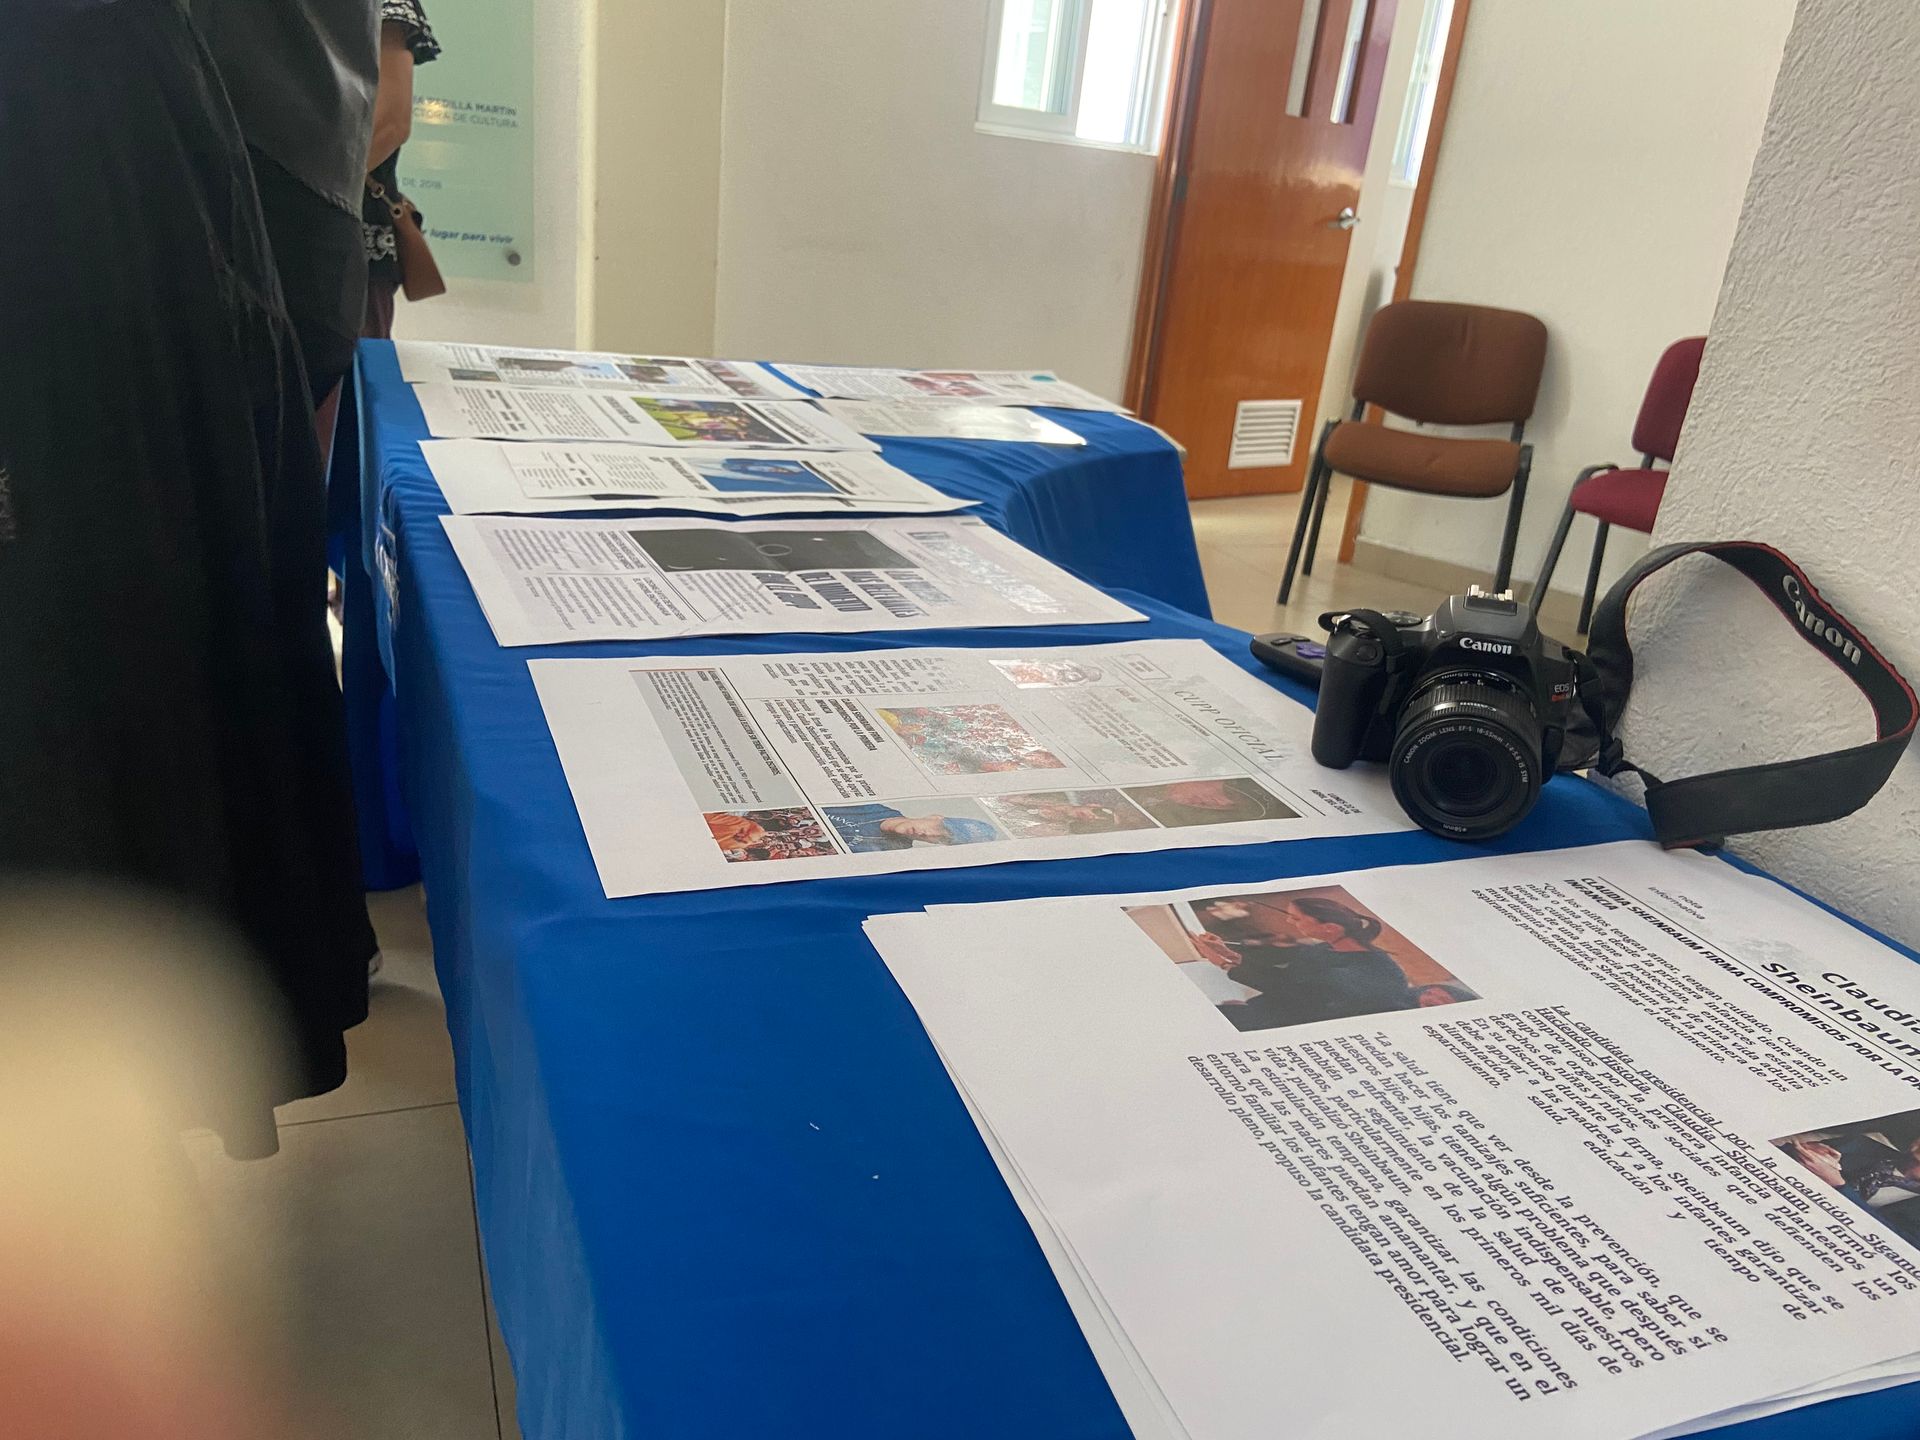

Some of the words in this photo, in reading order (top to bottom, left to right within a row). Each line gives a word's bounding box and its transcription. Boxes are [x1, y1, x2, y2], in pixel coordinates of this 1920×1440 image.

[430, 228, 459, 240] lugar
[461, 232, 487, 242] para
[1460, 637, 1512, 655] Canon
[1554, 683, 1569, 693] EOS
[1782, 575, 1861, 665] Canon
[1174, 690, 1220, 716] CUPP
[1215, 717, 1285, 761] OFICIAL
[1404, 744, 1419, 764] CANON
[1419, 732, 1437, 745] ZOOM
[1439, 727, 1455, 735] LENS
[1477, 728, 1503, 743] 18-55mm
[1471, 889, 1521, 922] aspirantes
[1514, 922, 1600, 971] presidenciales
[1589, 971, 1606, 981] en
[1603, 981, 1649, 1006] firmar
[1643, 1007, 1661, 1015] el
[1655, 1016, 1725, 1064] documento.
[1561, 878, 1620, 910] INFANCIA
[1580, 877, 1632, 906] CLAUDIA
[1621, 905, 1705, 950] SHEINBAUM
[1697, 950, 1746, 977] FIRMA
[1739, 977, 1852, 1041] COMPROMISOS
[1843, 1041, 1886, 1062] POR
[1877, 1061, 1905, 1076] LA
[1647, 886, 1706, 920] informativa
[1678, 895, 1703, 909] nota
[1421, 1024, 1500, 1088] esparcimiento.
[1563, 897, 1583, 908] los
[1579, 908, 1611, 927] niños
[1602, 927, 1648, 952] tengan
[1643, 952, 1680, 974] amor,
[1680, 974, 1723, 1000] tengan
[1722, 1001, 1773, 1035] cuidado.
[1776, 1035, 1827, 1067] Cuando
[1826, 1068, 1848, 1081] un
[1311, 1039, 1358, 1075] puedan
[1358, 1079, 1415, 1130] enfrentar,
[1416, 1134, 1435, 1147] la
[1436, 1151, 1511, 1219] vacunación
[1512, 1225, 1615, 1320] indispensable,
[1616, 1326, 1665, 1361] pero
[1390, 1050, 1429, 1076] salud
[1424, 1080, 1458, 1105] tiene
[1456, 1109, 1485, 1129] que
[1487, 1133, 1513, 1152] ver
[1512, 1158, 1555, 1191] desde
[1553, 1195, 1574, 1209] la
[1570, 1213, 1660, 1288] prevención,
[1665, 1294, 1702, 1320] que
[1704, 1326, 1728, 1343] se
[1437, 1022, 1511, 1081] alimentación,
[1526, 1095, 1569, 1125] salud,
[1582, 1140, 1653, 1195] educación
[1665, 1211, 1687, 1219] y
[1703, 1238, 1760, 1282] tiempo
[1781, 1303, 1807, 1320] de
[1470, 1017, 1491, 1030] En
[1487, 1031, 1508, 1043] su
[1504, 1043, 1558, 1081] discurso
[1554, 1081, 1609, 1123] durante
[1604, 1122, 1623, 1135] la
[1620, 1136, 1664, 1170] firma,
[1666, 1171, 1751, 1237] Sheinbaum
[1751, 1239, 1786, 1263] dijo
[1785, 1267, 1821, 1292] que
[1820, 1295, 1844, 1310] se
[1532, 1007, 1596, 1048] Haciendo
[1595, 1054, 1658, 1095] Historia,
[1659, 1103, 1721, 1141] Claudia
[1721, 1149, 1817, 1214] Sheinbaum,
[1823, 1224, 1879, 1259] firmó
[1885, 1269, 1920, 1290] los
[1549, 1004, 1571, 1017] La
[1570, 1021, 1634, 1064] candidata
[1633, 1068, 1724, 1127] presidencial
[1720, 1132, 1755, 1152] por
[1756, 1156, 1778, 1170] la
[1780, 1175, 1855, 1227] coalición
[1186, 1055, 1237, 1105] desarrollo
[1227, 1106, 1265, 1140] pleno,
[1257, 1140, 1312, 1187] propuso
[1305, 1187, 1324, 1201] la
[1319, 1203, 1383, 1266] candidata
[1372, 1267, 1470, 1362] presidencial.
[1242, 1049, 1261, 1062] La
[1259, 1066, 1326, 1130] estimulación
[1325, 1134, 1384, 1193] temprana,
[1383, 1199, 1460, 1264] garantizar
[1457, 1270, 1485, 1292] las
[1486, 1299, 1578, 1389] condiciones
[1275, 1044, 1332, 1092] pequeños,
[1325, 1094, 1423, 1181] particularmente
[1421, 1185, 1443, 1201] en
[1439, 1203, 1466, 1223] los
[1458, 1226, 1532, 1287] primeros
[1528, 1291, 1565, 1316] mil
[1559, 1320, 1597, 1351] días
[1596, 1355, 1622, 1375] de
